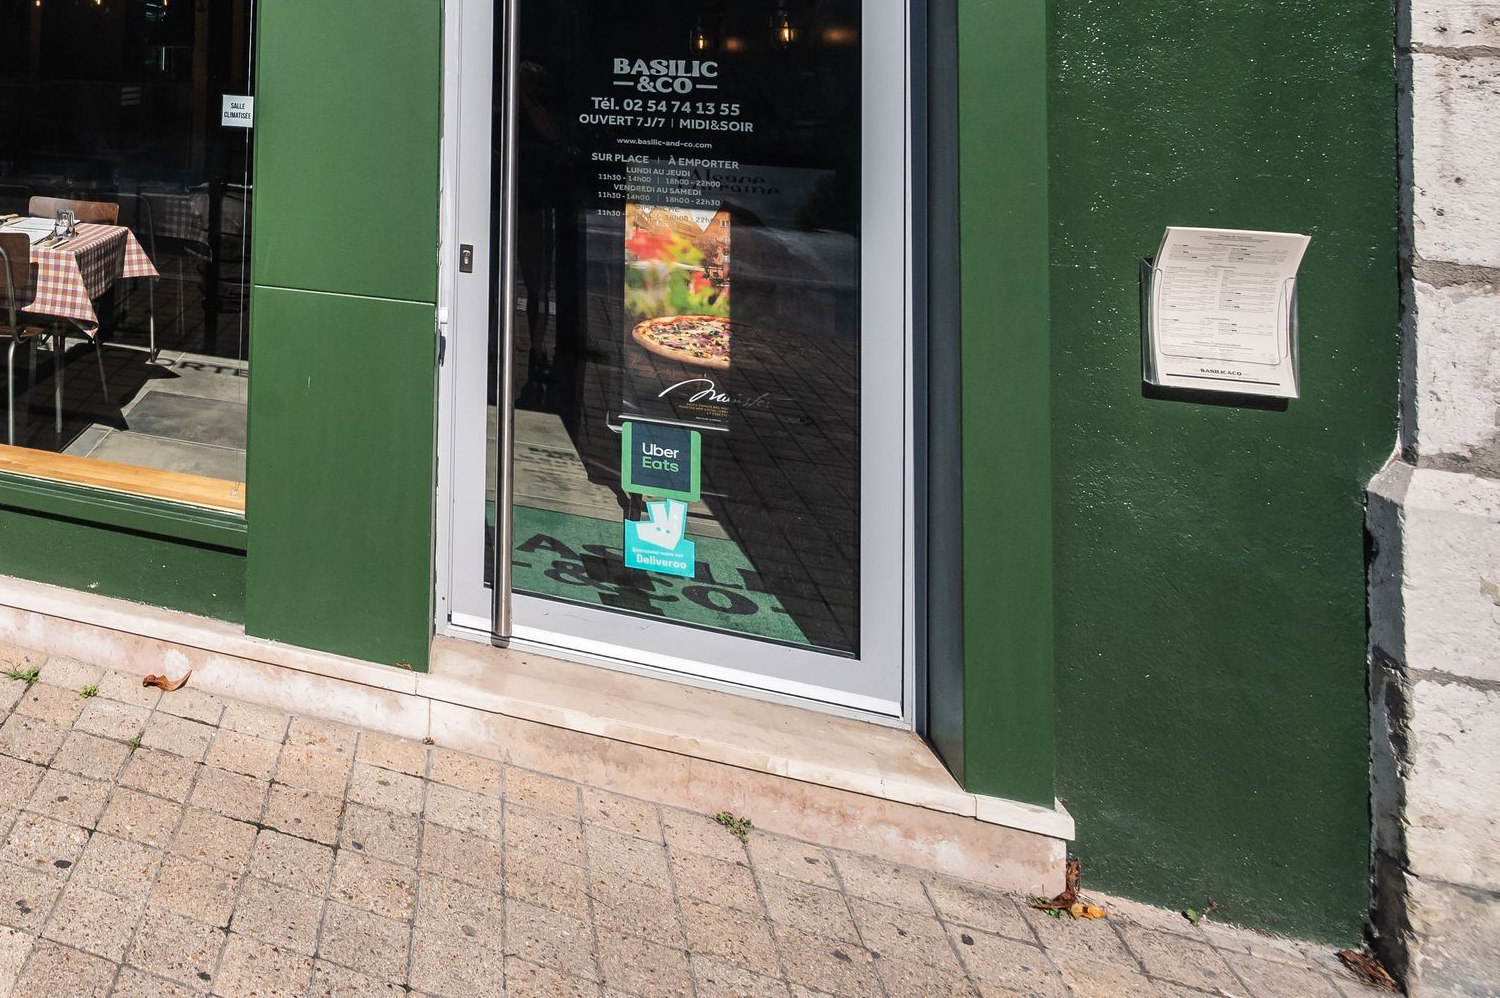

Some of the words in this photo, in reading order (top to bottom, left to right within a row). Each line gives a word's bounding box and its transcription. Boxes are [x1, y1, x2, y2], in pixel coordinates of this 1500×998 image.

[613, 57, 718, 78] BASILIC
[636, 76, 693, 94] &CO
[230, 102, 245, 110] SALLE
[591, 97, 619, 111] Tél.
[623, 99, 643, 112] 02
[647, 100, 667, 113] 54
[671, 101, 691, 114] 74
[696, 102, 715, 115] 13
[720, 103, 740, 116] 55
[579, 113, 633, 126] OUVERT
[679, 119, 754, 133] MIDI&SOIR
[617, 138, 712, 149] www.basilic-and-co.com
[591, 152, 613, 162] SUR
[615, 154, 650, 164] PLACE
[678, 158, 739, 170] EMPORTER
[626, 166, 652, 175] LUNDI
[666, 169, 691, 177] JEUDI
[598, 191, 621, 199] 11h30
[613, 184, 655, 193] VENDREDI
[669, 188, 701, 196] SAMEDI
[642, 442, 680, 459] Uber
[642, 456, 680, 473] Eats
[636, 553, 687, 570] Deliveroo
